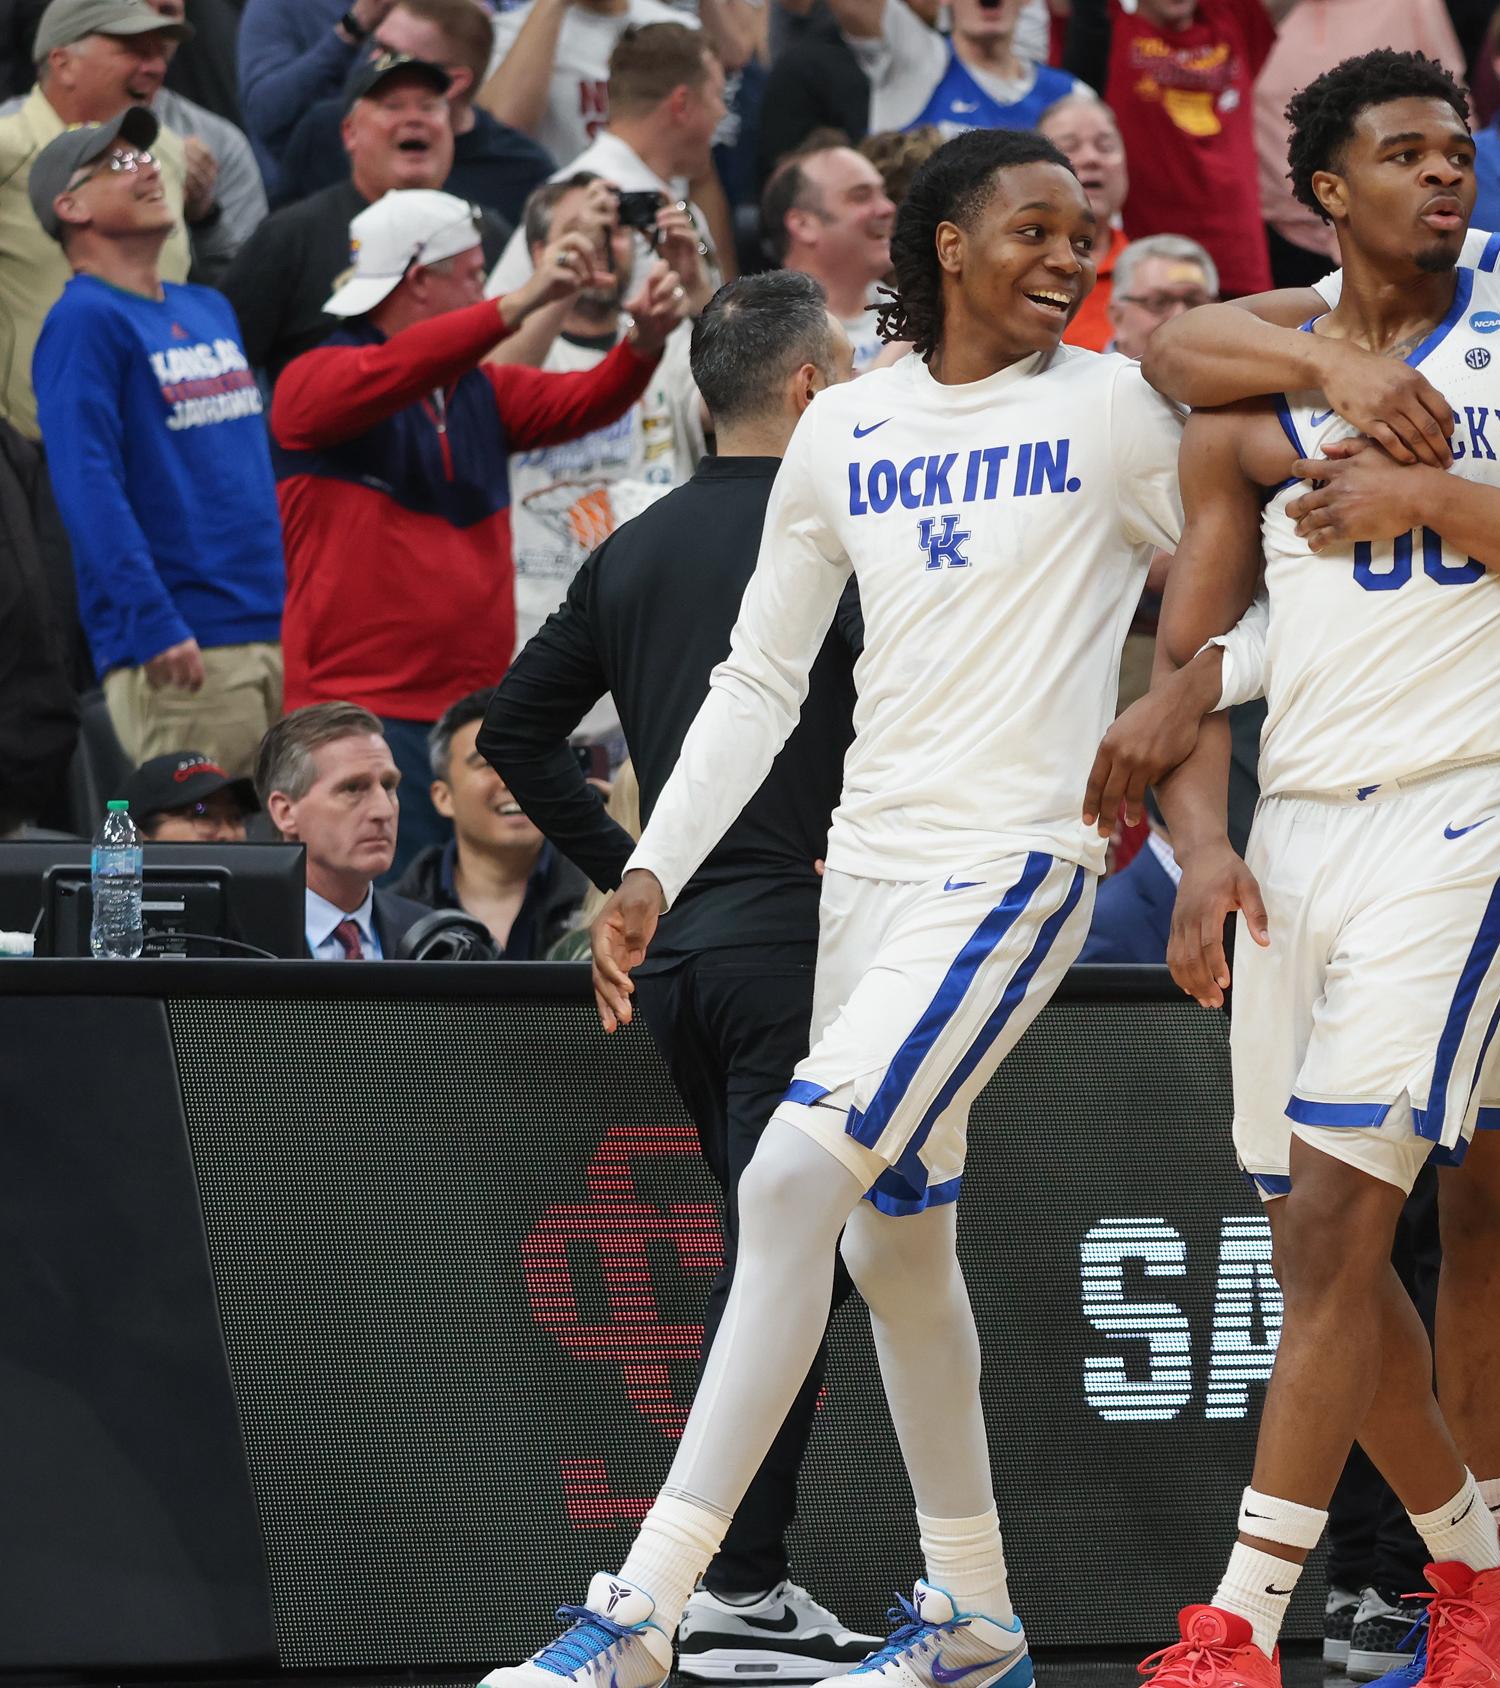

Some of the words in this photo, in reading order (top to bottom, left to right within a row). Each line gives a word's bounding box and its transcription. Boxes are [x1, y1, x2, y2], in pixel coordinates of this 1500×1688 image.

[1466, 350, 1491, 369] SEC
[849, 452, 960, 517] LOCK
[963, 446, 1010, 502] IT
[1013, 439, 1082, 497] IN.
[917, 514, 972, 571] UK
